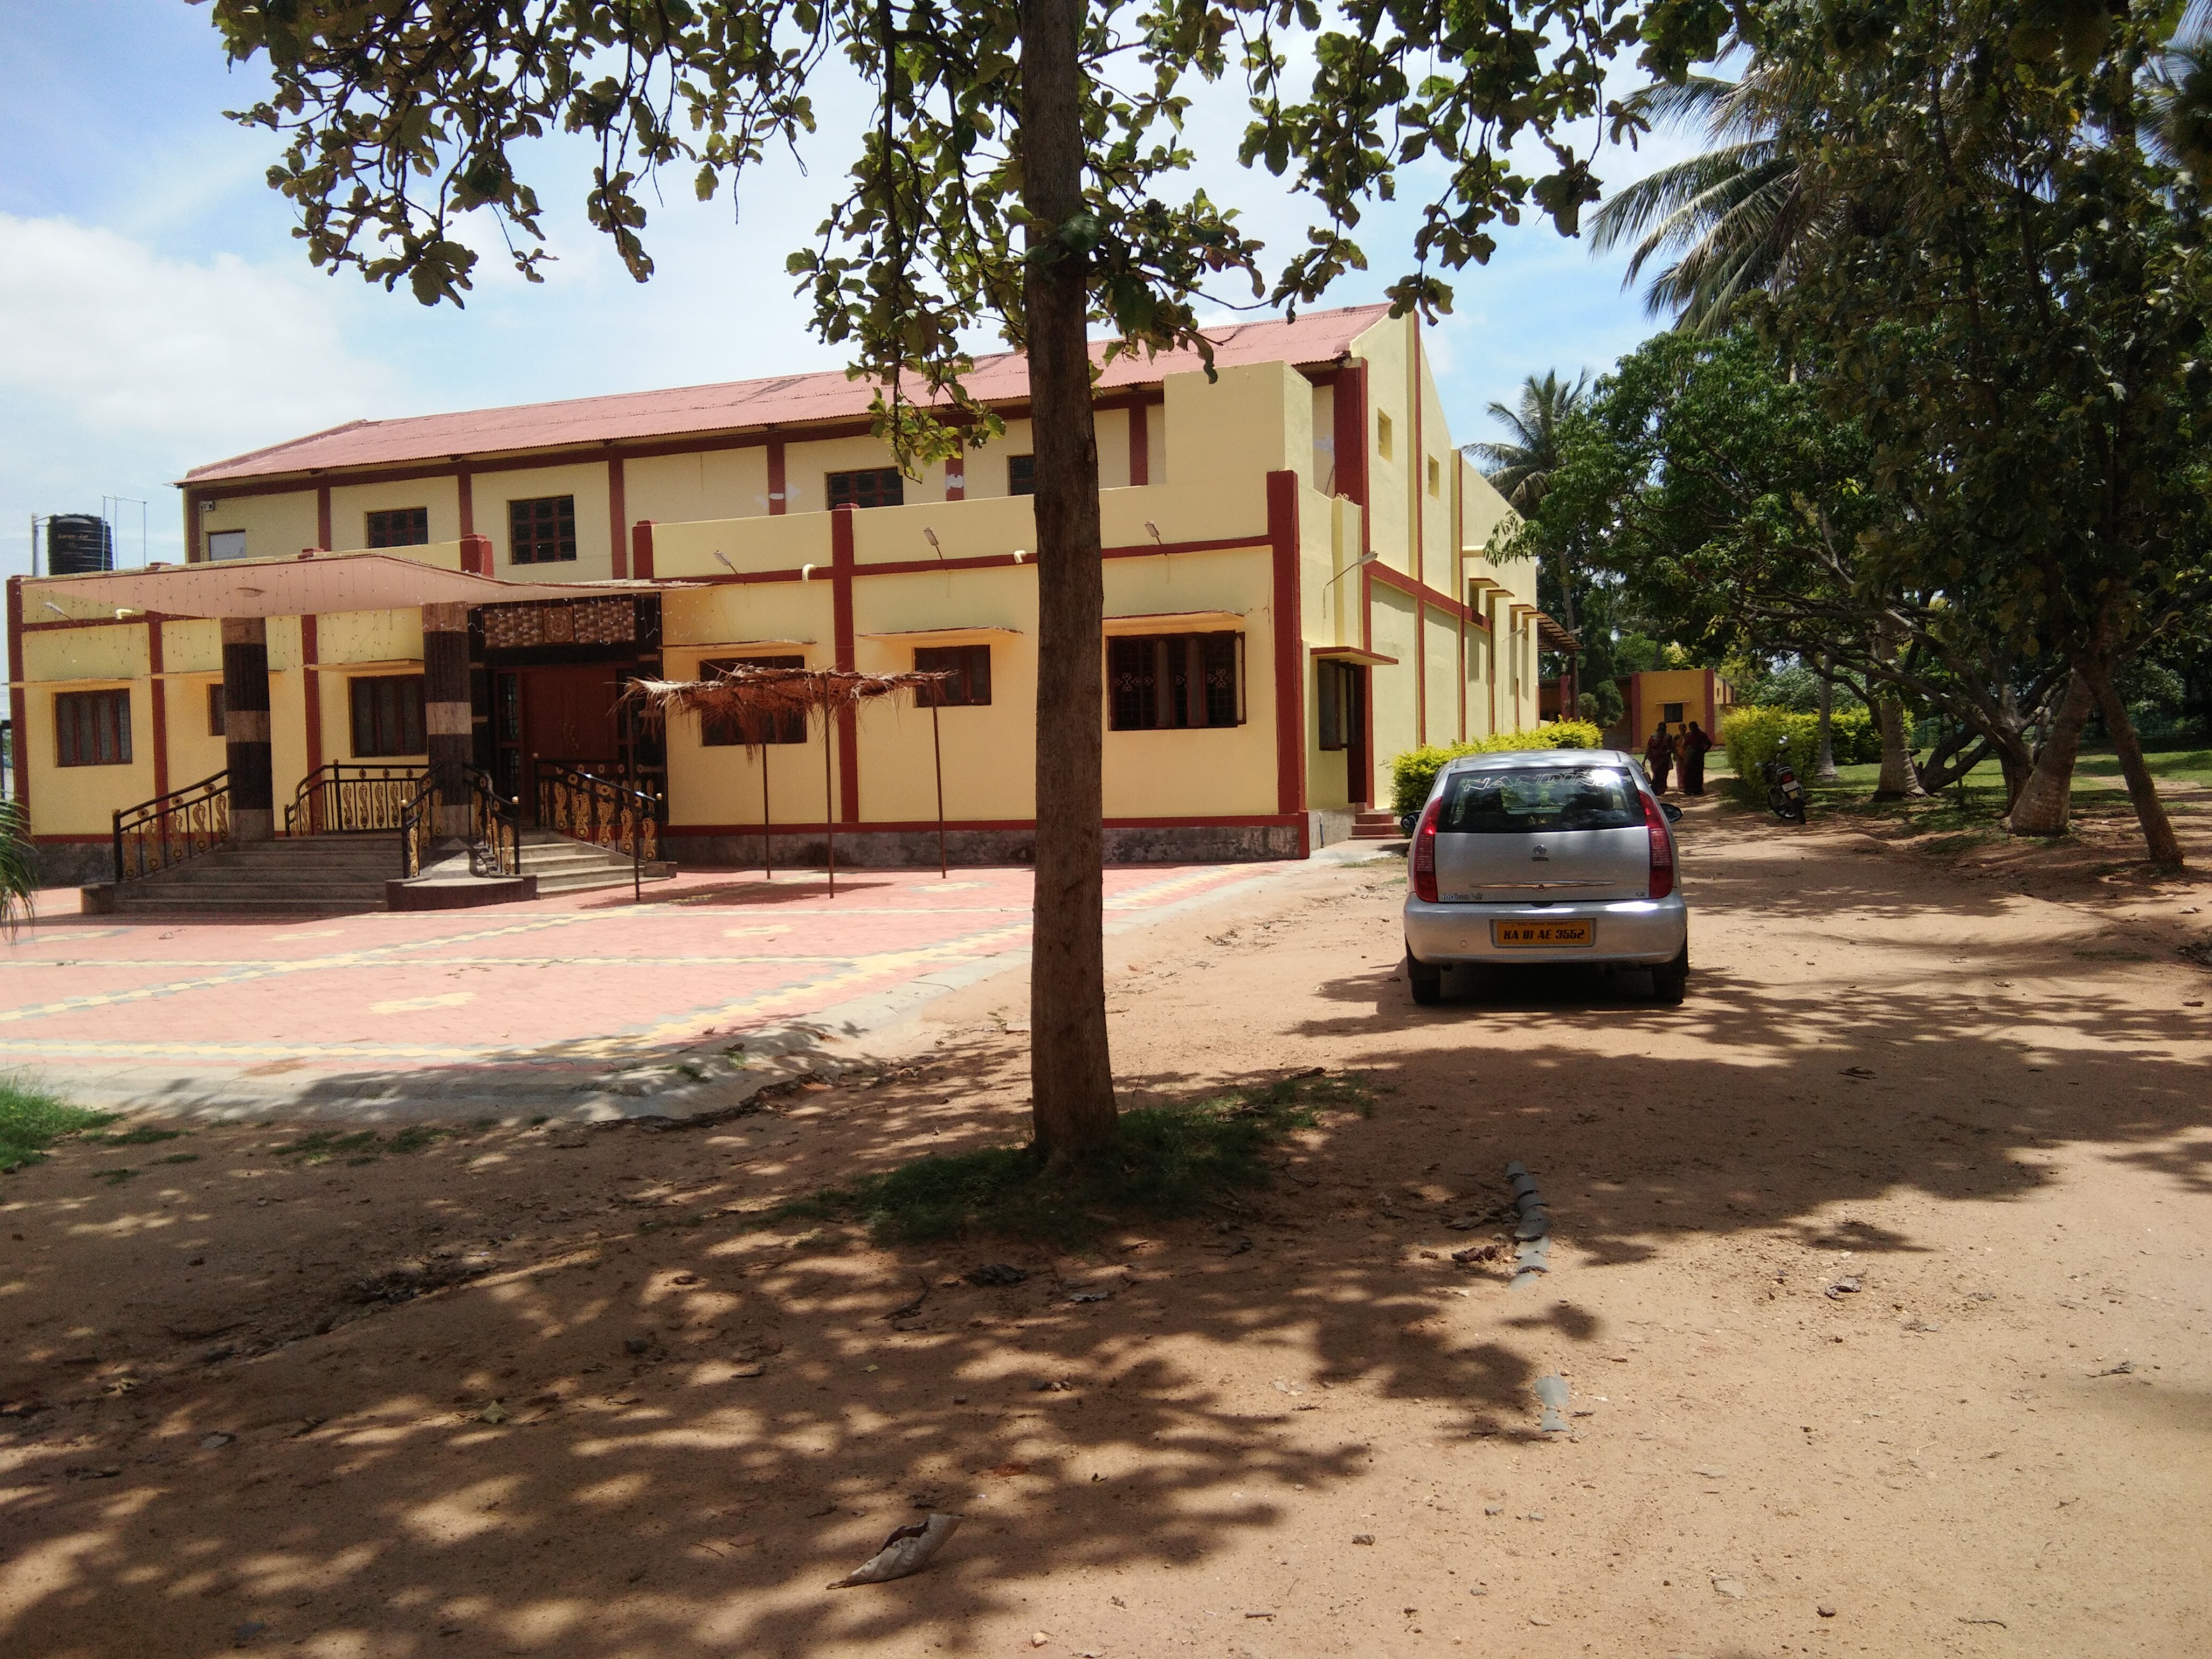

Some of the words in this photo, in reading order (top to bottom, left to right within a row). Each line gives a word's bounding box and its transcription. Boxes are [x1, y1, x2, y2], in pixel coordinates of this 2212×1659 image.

[1503, 930, 1519, 940] KA
[1522, 930, 1533, 940] 01
[1537, 929, 1551, 940] AE
[1555, 929, 1585, 939] 3552
